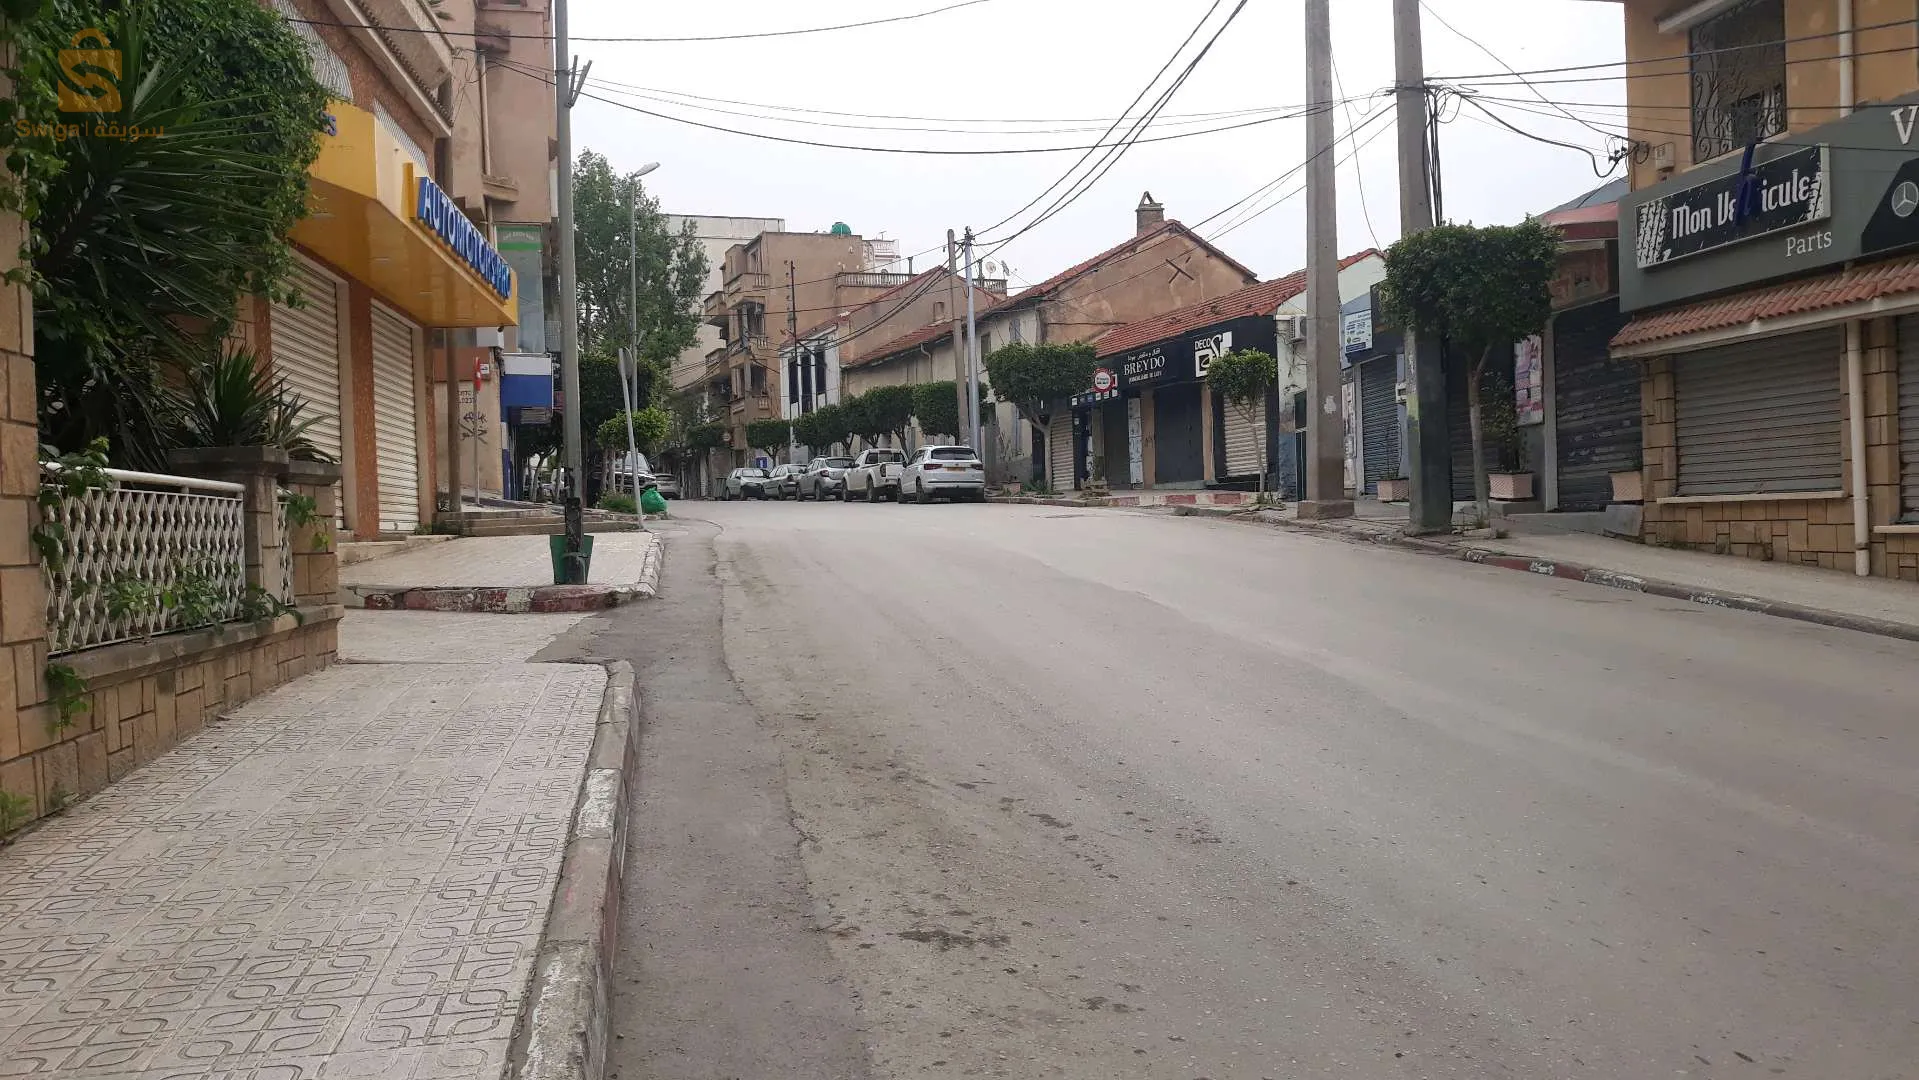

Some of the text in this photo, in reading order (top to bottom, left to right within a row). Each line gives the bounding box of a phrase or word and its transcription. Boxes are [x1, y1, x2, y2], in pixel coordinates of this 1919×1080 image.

[1672, 168, 1810, 240] Mon Veicule
[1786, 231, 1832, 258] Parts
[1194, 337, 1212, 351] DECO
[1123, 355, 1166, 376] BREYDO
